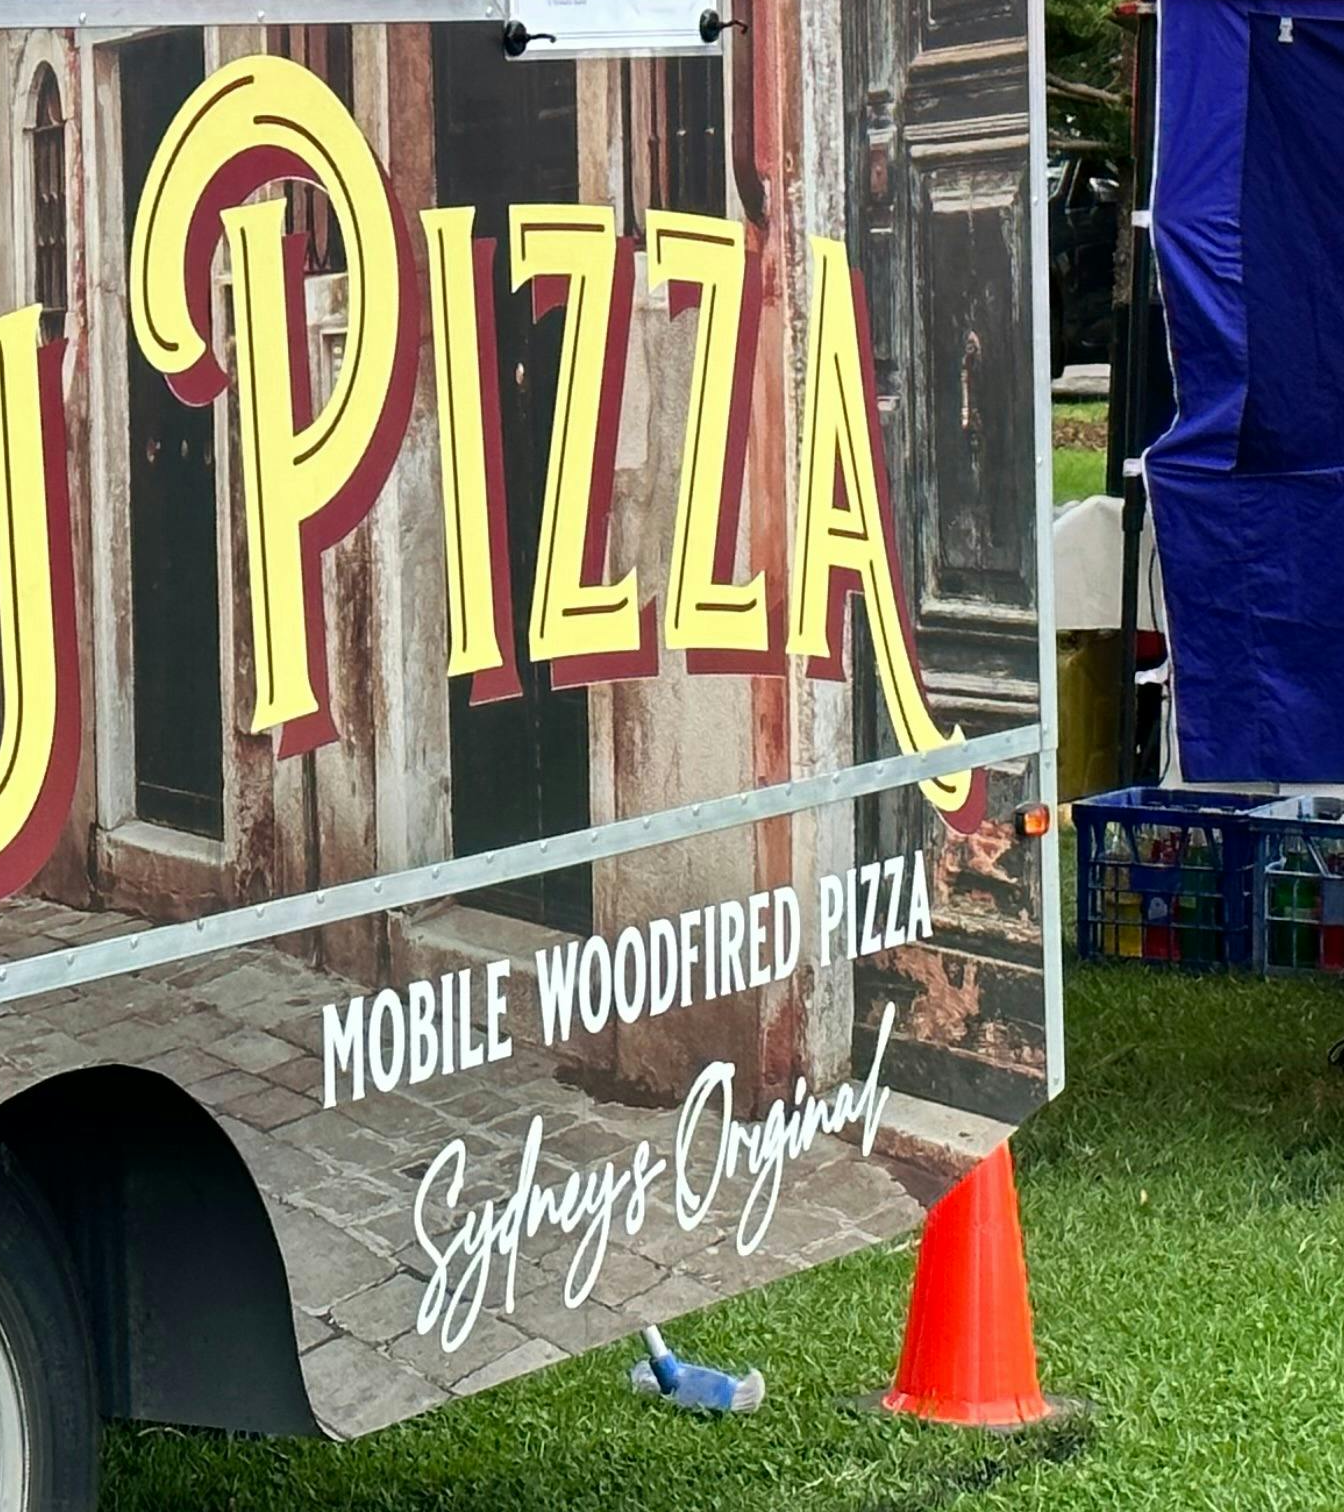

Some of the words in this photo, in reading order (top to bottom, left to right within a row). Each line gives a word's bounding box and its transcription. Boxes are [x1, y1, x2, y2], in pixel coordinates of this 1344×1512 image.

[130, 53, 981, 826] PIZZA
[322, 958, 513, 1109] MOBILE
[537, 885, 801, 1046] WOODFIRED
[820, 849, 934, 967] PIZZA
